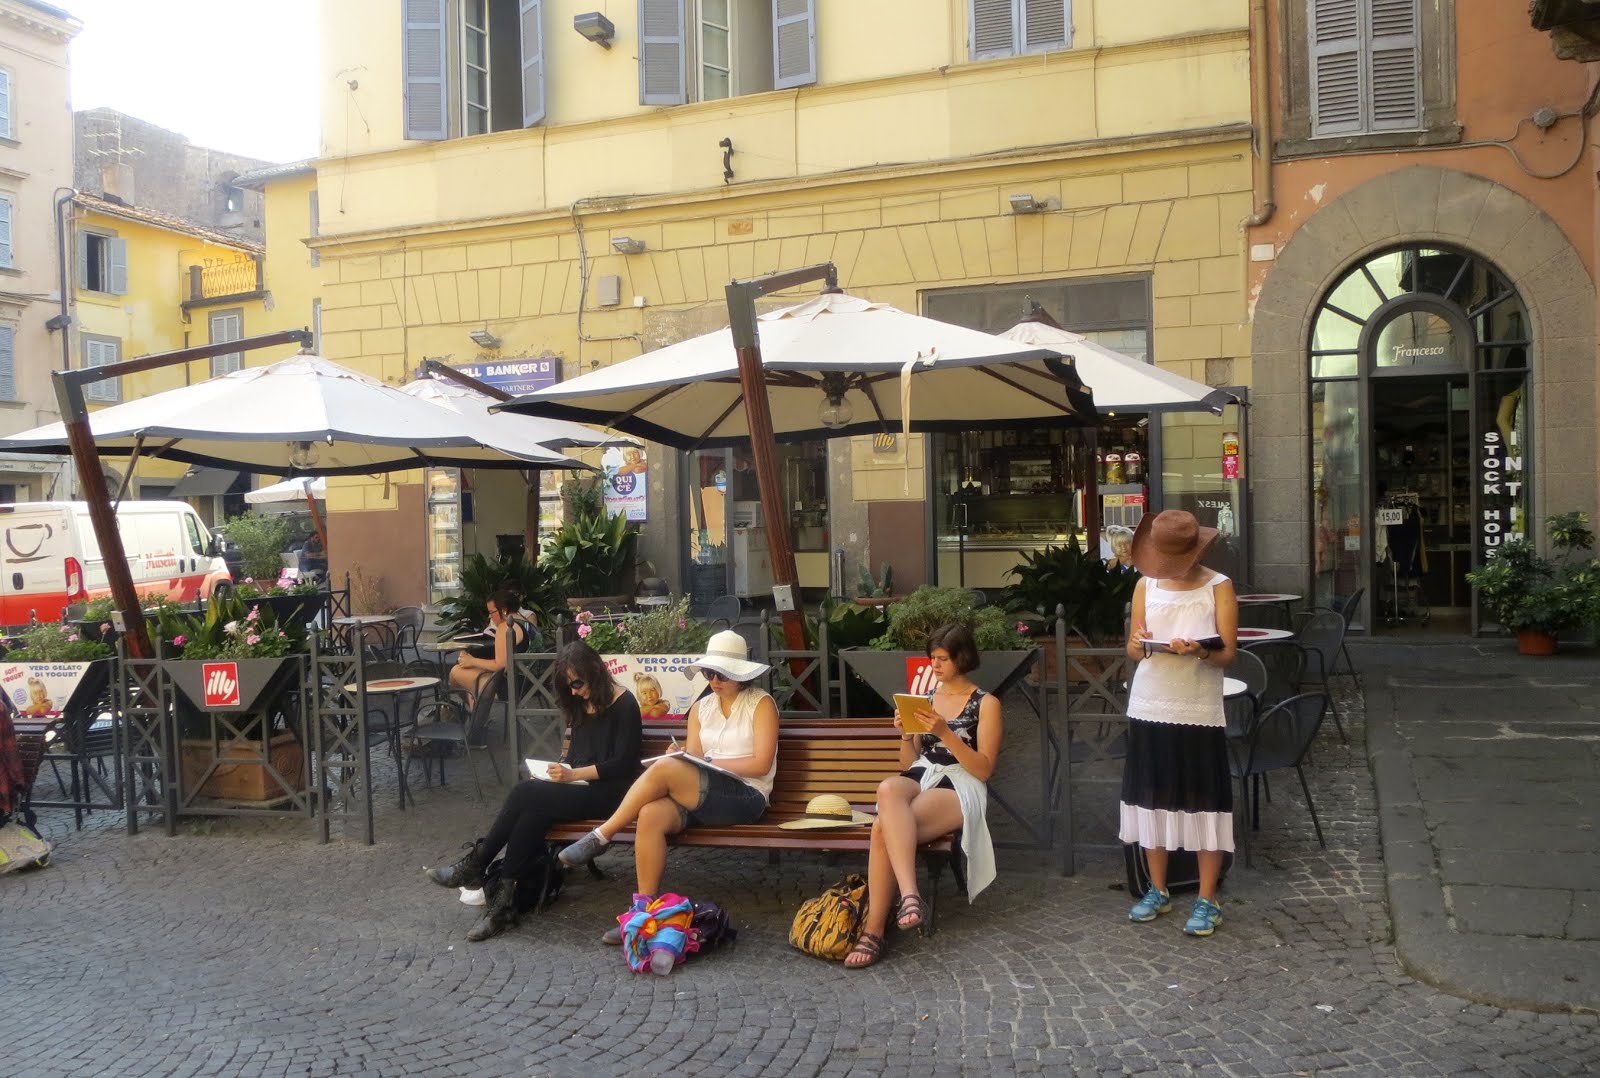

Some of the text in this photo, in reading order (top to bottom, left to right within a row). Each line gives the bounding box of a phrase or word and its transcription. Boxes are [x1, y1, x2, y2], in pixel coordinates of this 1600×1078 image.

[1392, 344, 1444, 362] Francesco
[487, 363, 537, 376] BANKER
[501, 384, 534, 392] PARTNERS
[874, 433, 895, 450] illy
[615, 475, 633, 485] QUI
[1504, 431, 1524, 543] INTIM
[1483, 432, 1500, 560] STOCK HOUS
[4, 666, 17, 676] SOFT
[207, 670, 235, 700] illy
